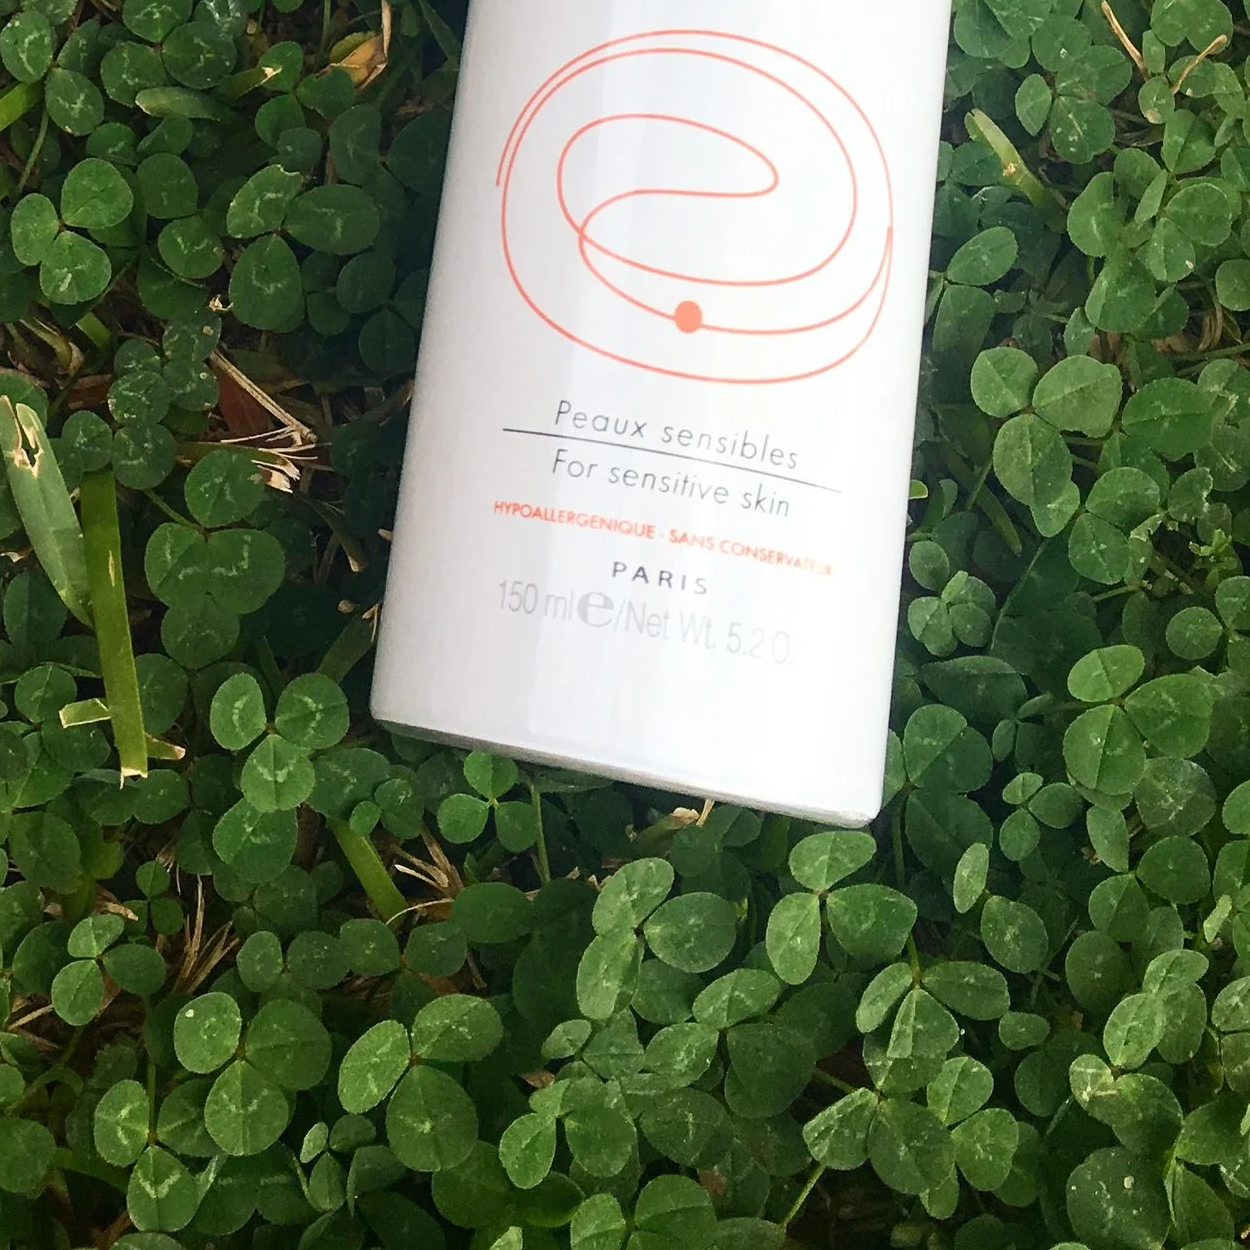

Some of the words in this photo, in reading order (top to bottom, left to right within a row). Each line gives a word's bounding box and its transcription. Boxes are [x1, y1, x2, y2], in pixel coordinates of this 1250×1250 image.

[555, 399, 648, 440] Peaux
[661, 422, 799, 470] sensibles
[551, 448, 598, 480] For
[608, 458, 729, 505] sensitive
[741, 483, 791, 519] skin
[493, 500, 656, 540] HYPOALLERGENIQUE
[668, 528, 715, 552] SANS
[498, 579, 539, 615] 150
[611, 561, 708, 595] PARIS
